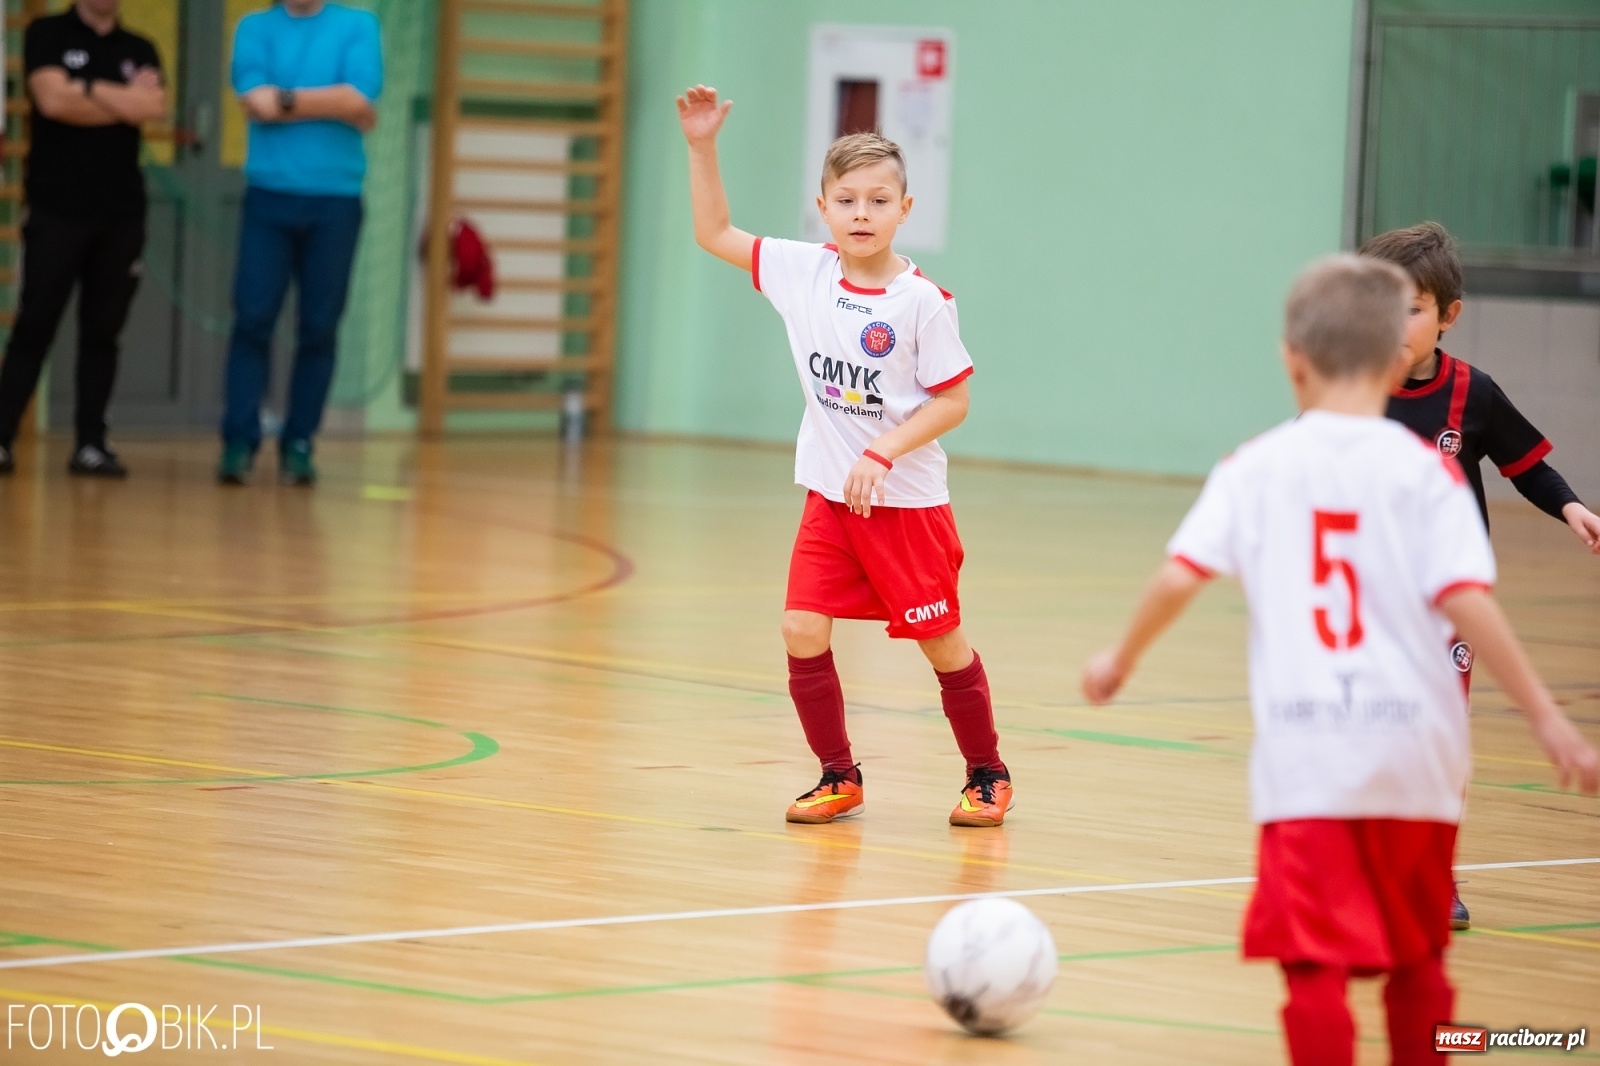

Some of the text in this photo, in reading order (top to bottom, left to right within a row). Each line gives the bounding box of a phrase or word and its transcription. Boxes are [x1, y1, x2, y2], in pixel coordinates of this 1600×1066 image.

[809, 352, 882, 394] CMYK
[1312, 510, 1364, 650] 5
[904, 599, 948, 623] CMYK
